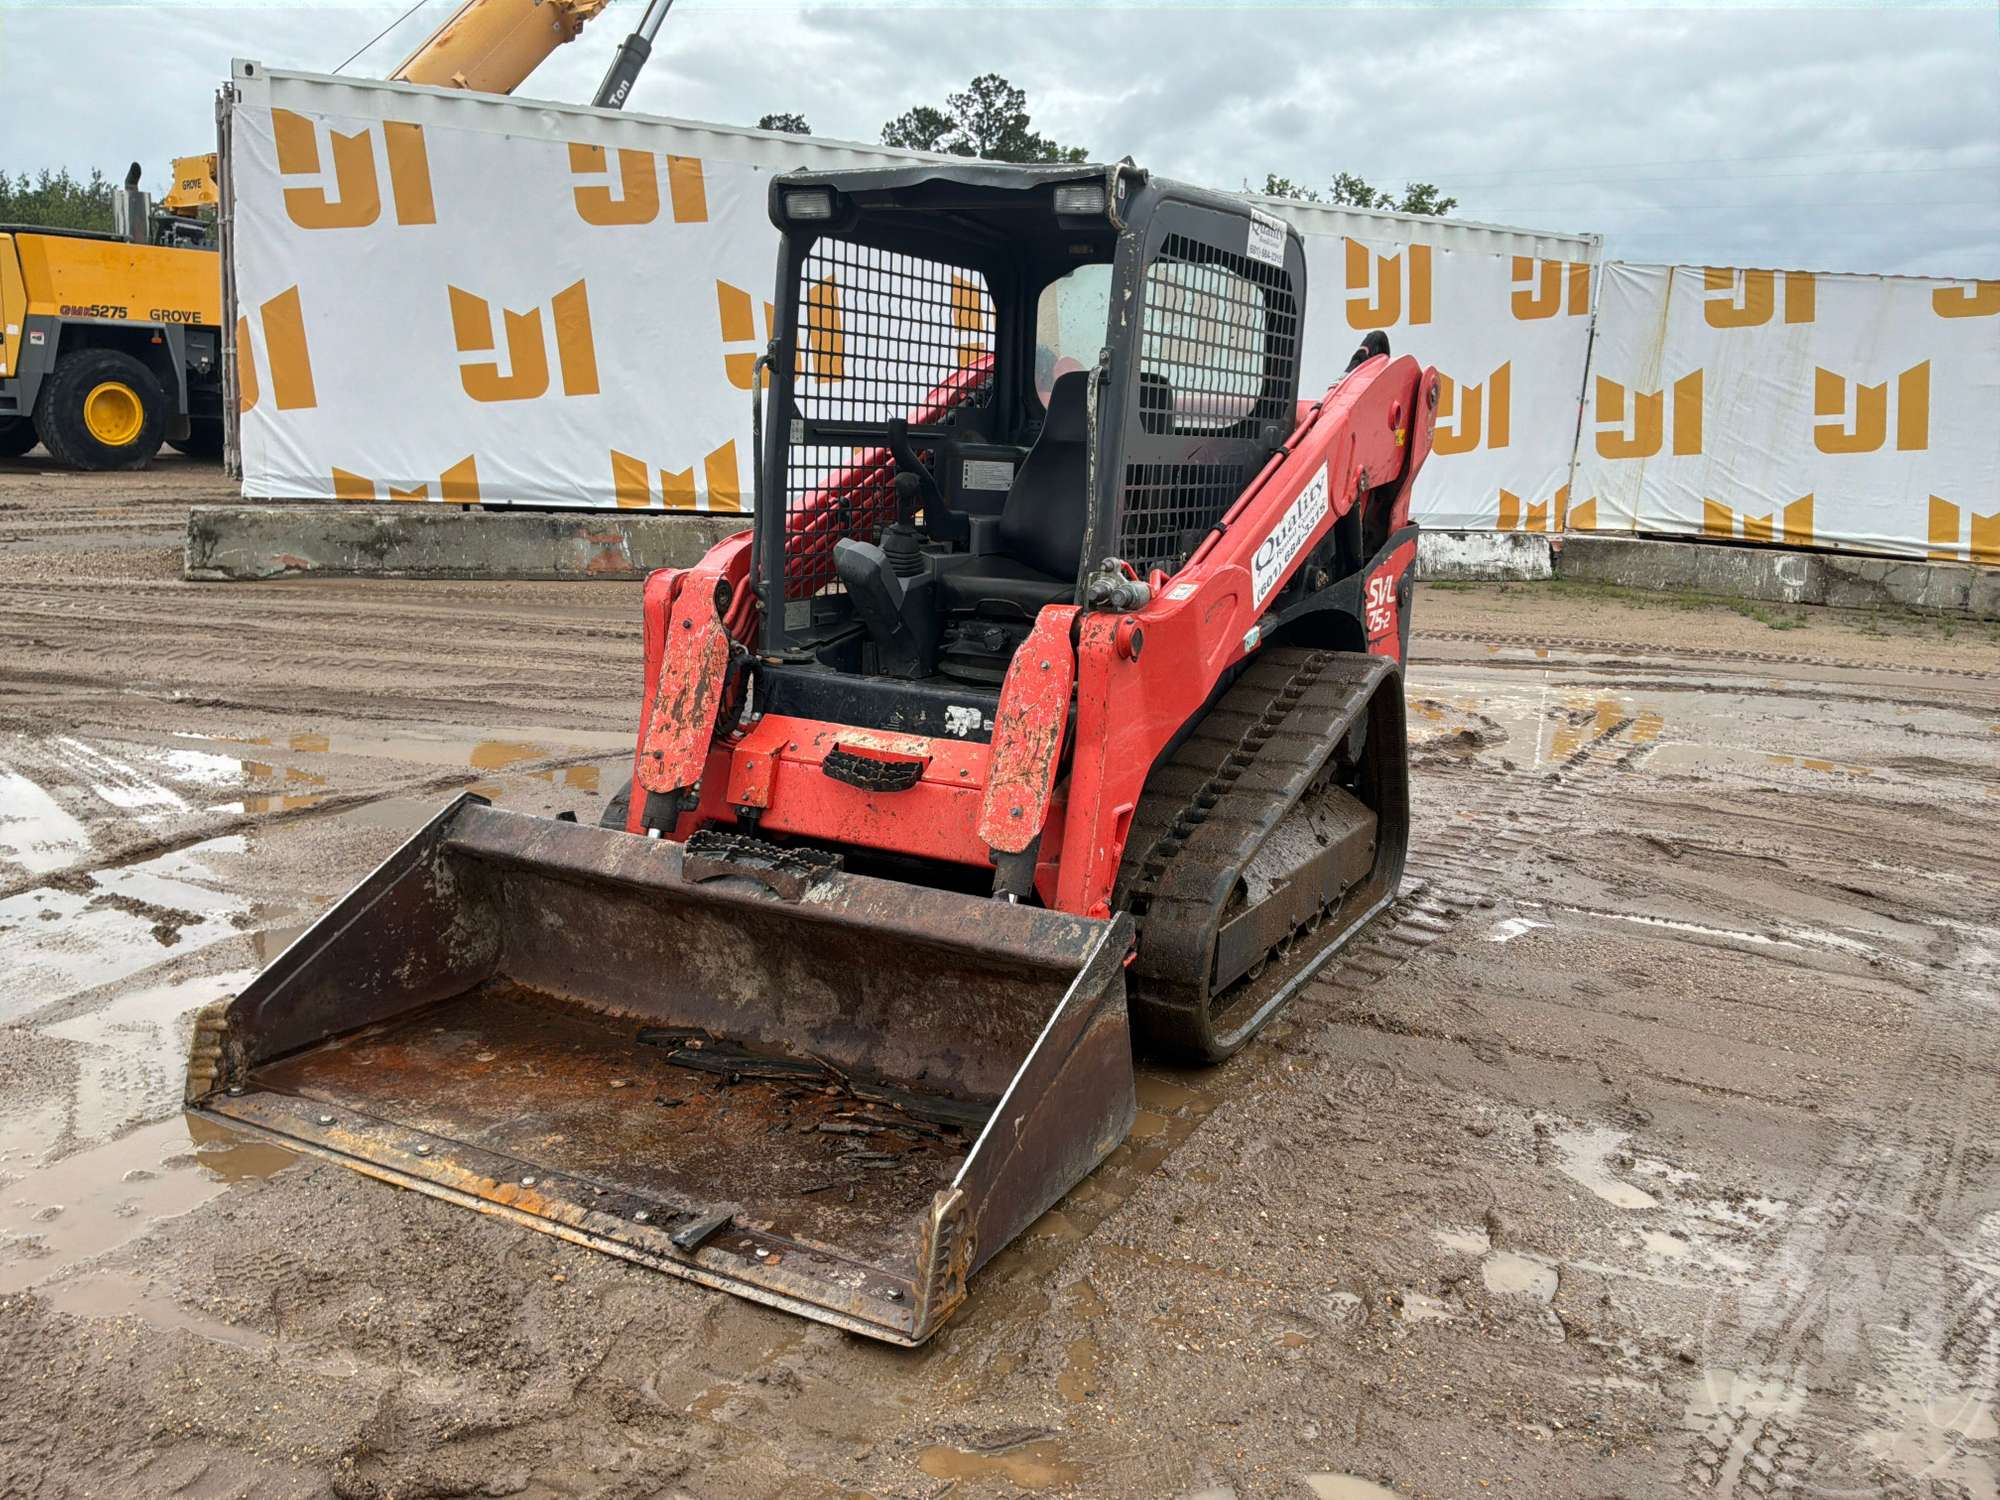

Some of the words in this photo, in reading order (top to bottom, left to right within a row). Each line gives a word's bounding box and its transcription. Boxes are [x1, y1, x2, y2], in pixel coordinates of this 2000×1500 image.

[608, 79, 630, 106] Ton
[182, 178, 202, 191] GROVE
[150, 308, 201, 323] GROVE
[1255, 472, 1325, 577] Quality
[1257, 562, 1283, 603] (601)
[1366, 574, 1397, 609] SVL
